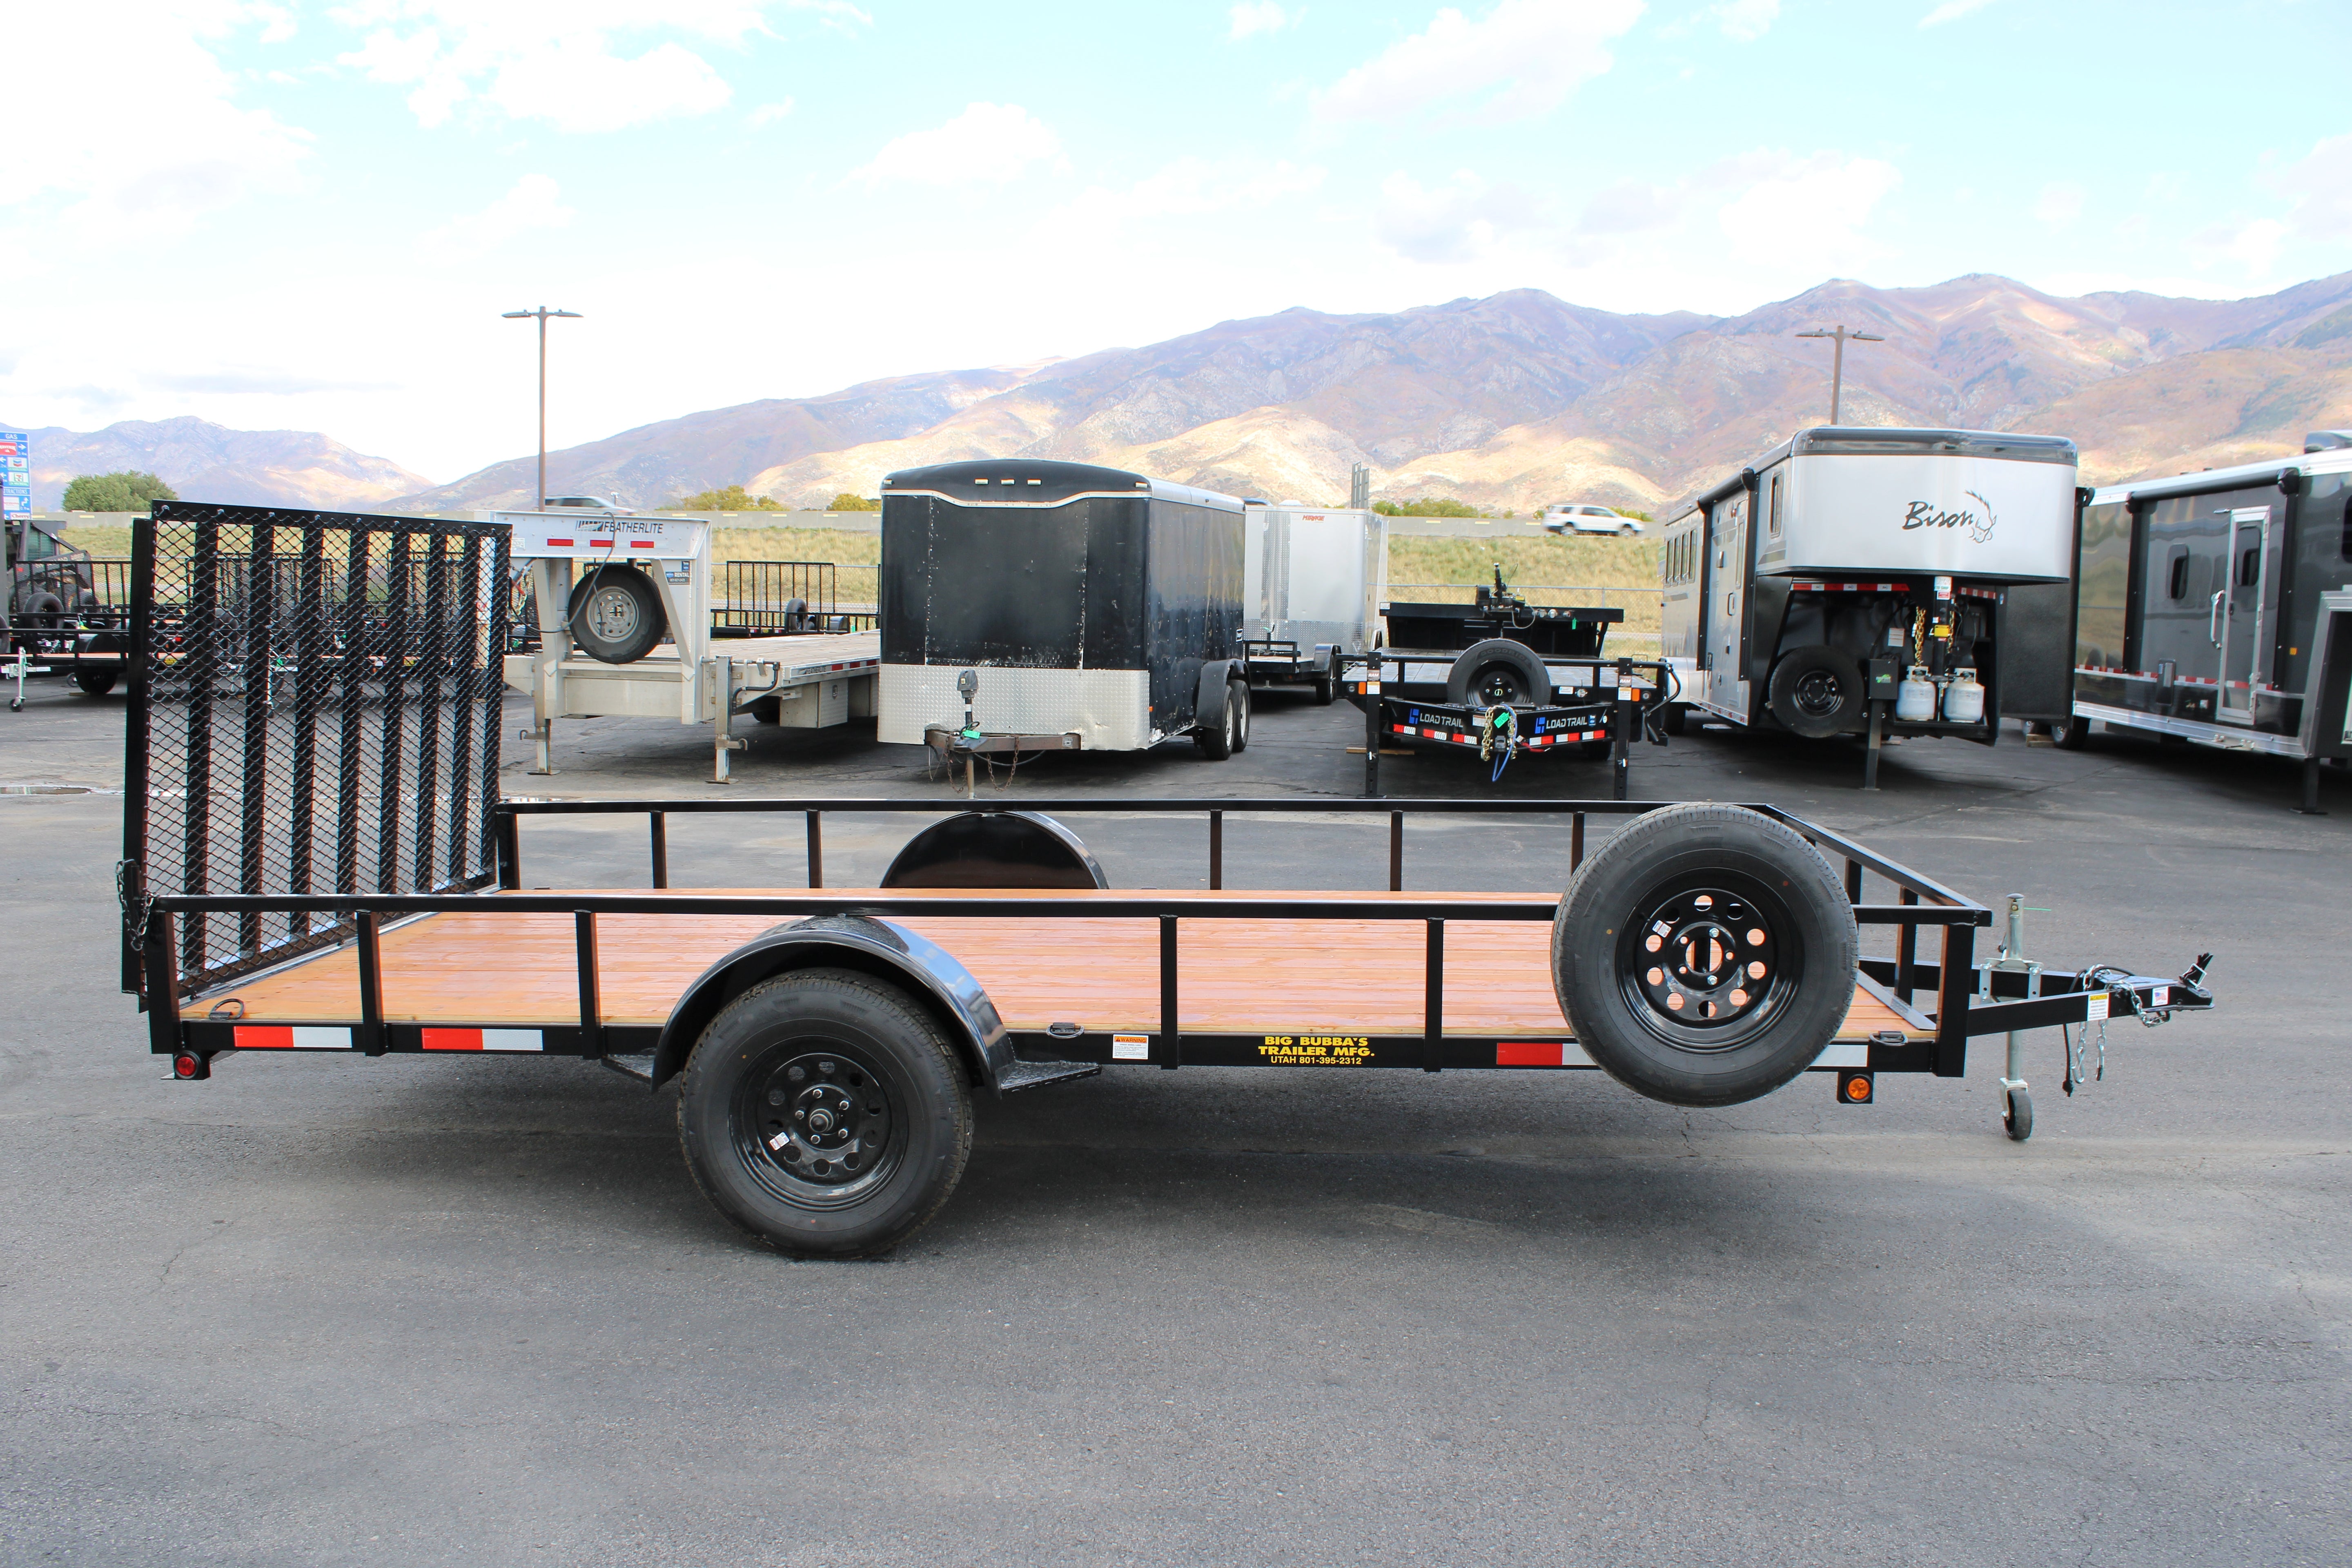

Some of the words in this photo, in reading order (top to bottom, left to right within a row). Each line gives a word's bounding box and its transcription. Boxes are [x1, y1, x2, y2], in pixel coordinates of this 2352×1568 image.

[1902, 501, 1974, 530] Bison
[604, 521, 664, 534] FEATHERLITE
[1420, 713, 1440, 724] LOAD
[1441, 717, 1463, 728] TRAIL
[1546, 719, 1566, 729] LOAD
[1567, 716, 1588, 726] TRAIL
[1265, 1036, 1293, 1045] BIG
[1300, 1037, 1368, 1046] BUBBA'S
[1258, 1046, 1326, 1056] TRAILER
[1333, 1047, 1375, 1057] MFG.
[1299, 1056, 1362, 1065] 801-395-2312
